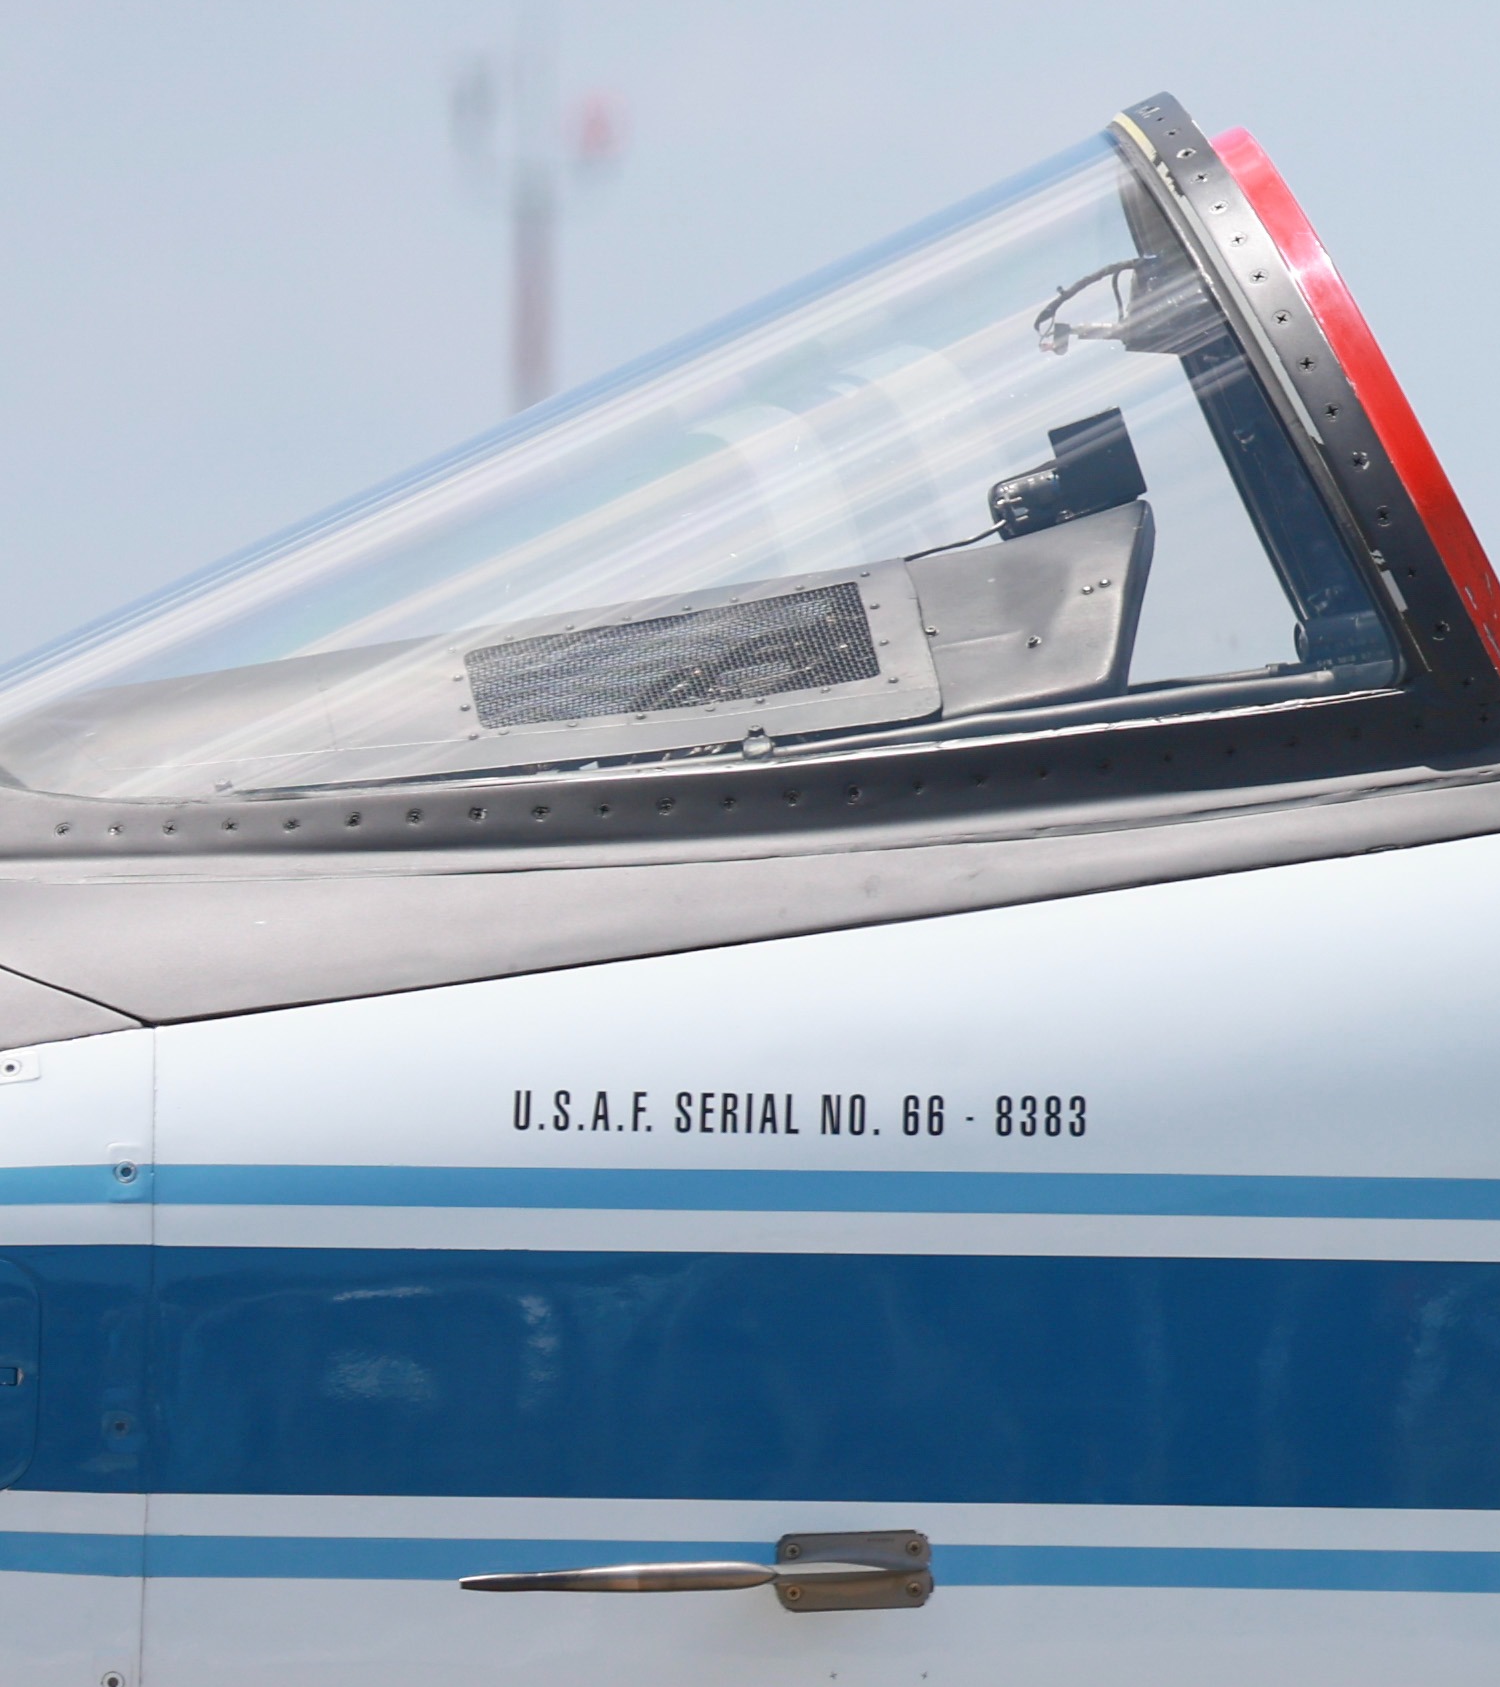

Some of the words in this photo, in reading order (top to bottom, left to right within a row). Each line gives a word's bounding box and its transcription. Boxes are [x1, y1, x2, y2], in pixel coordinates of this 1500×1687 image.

[514, 1089, 653, 1132] U.S.A.F.
[675, 1092, 799, 1135] SERIAL
[821, 1094, 881, 1136] NO.
[902, 1095, 945, 1137] 66
[995, 1095, 1087, 1138] 8383
